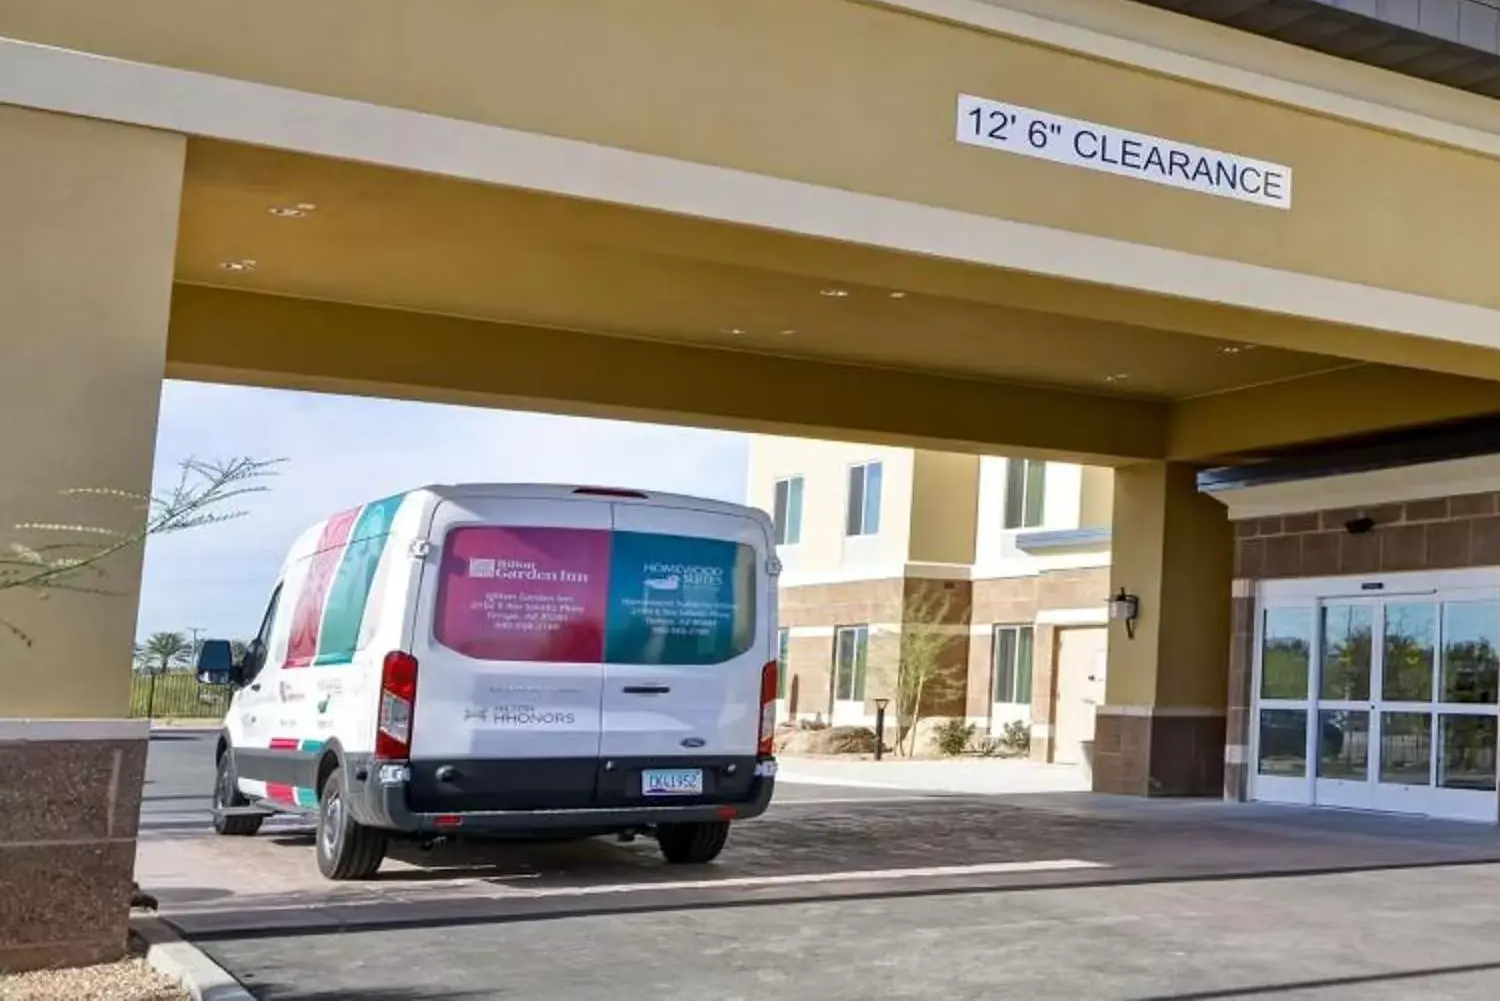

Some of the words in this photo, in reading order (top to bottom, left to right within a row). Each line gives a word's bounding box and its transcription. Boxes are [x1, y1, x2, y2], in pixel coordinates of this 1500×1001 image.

[968, 106, 1017, 141] 12'
[1027, 119, 1062, 149] 6"
[1072, 129, 1284, 200] CLEARANCE
[495, 567, 557, 581] Garden
[559, 569, 589, 583] Inn
[493, 712, 577, 724] HHONORS
